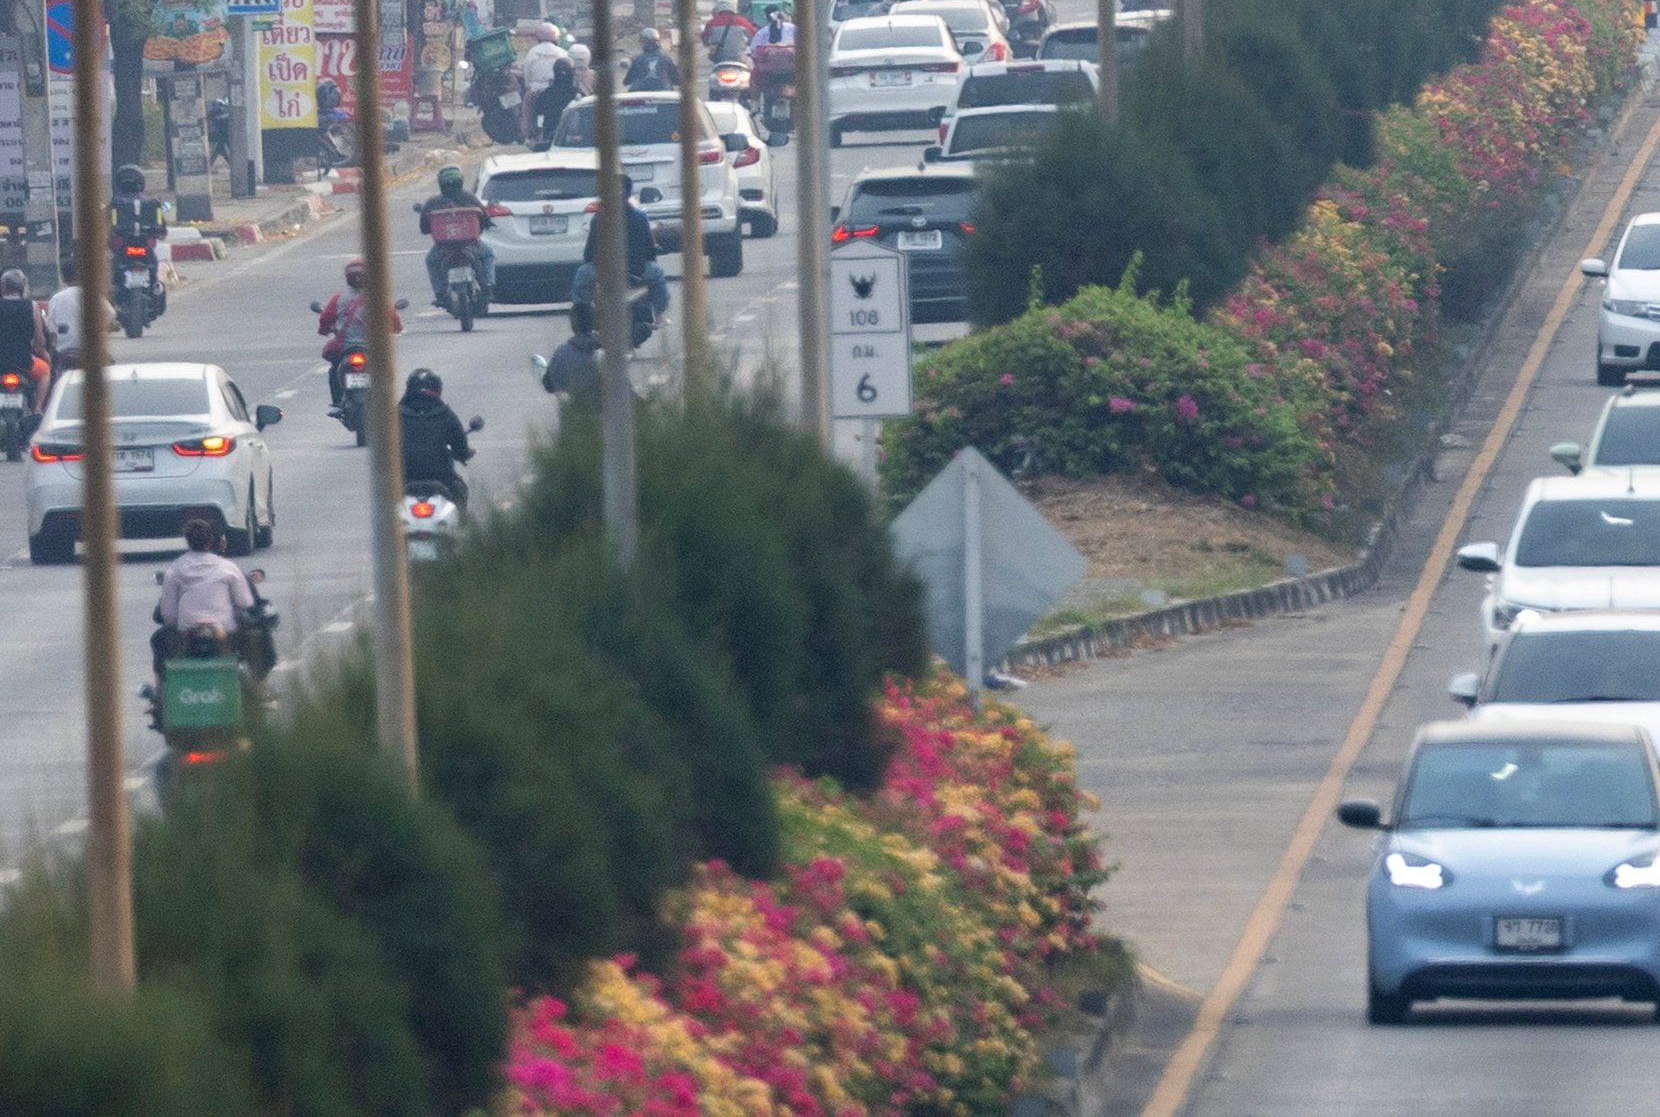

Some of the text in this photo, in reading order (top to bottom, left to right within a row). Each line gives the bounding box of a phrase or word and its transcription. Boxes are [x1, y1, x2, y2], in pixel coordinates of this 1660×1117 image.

[273, 87, 301, 118] ไก่
[850, 310, 879, 325] 108
[856, 372, 877, 402] 6
[179, 685, 226, 704] Grab
